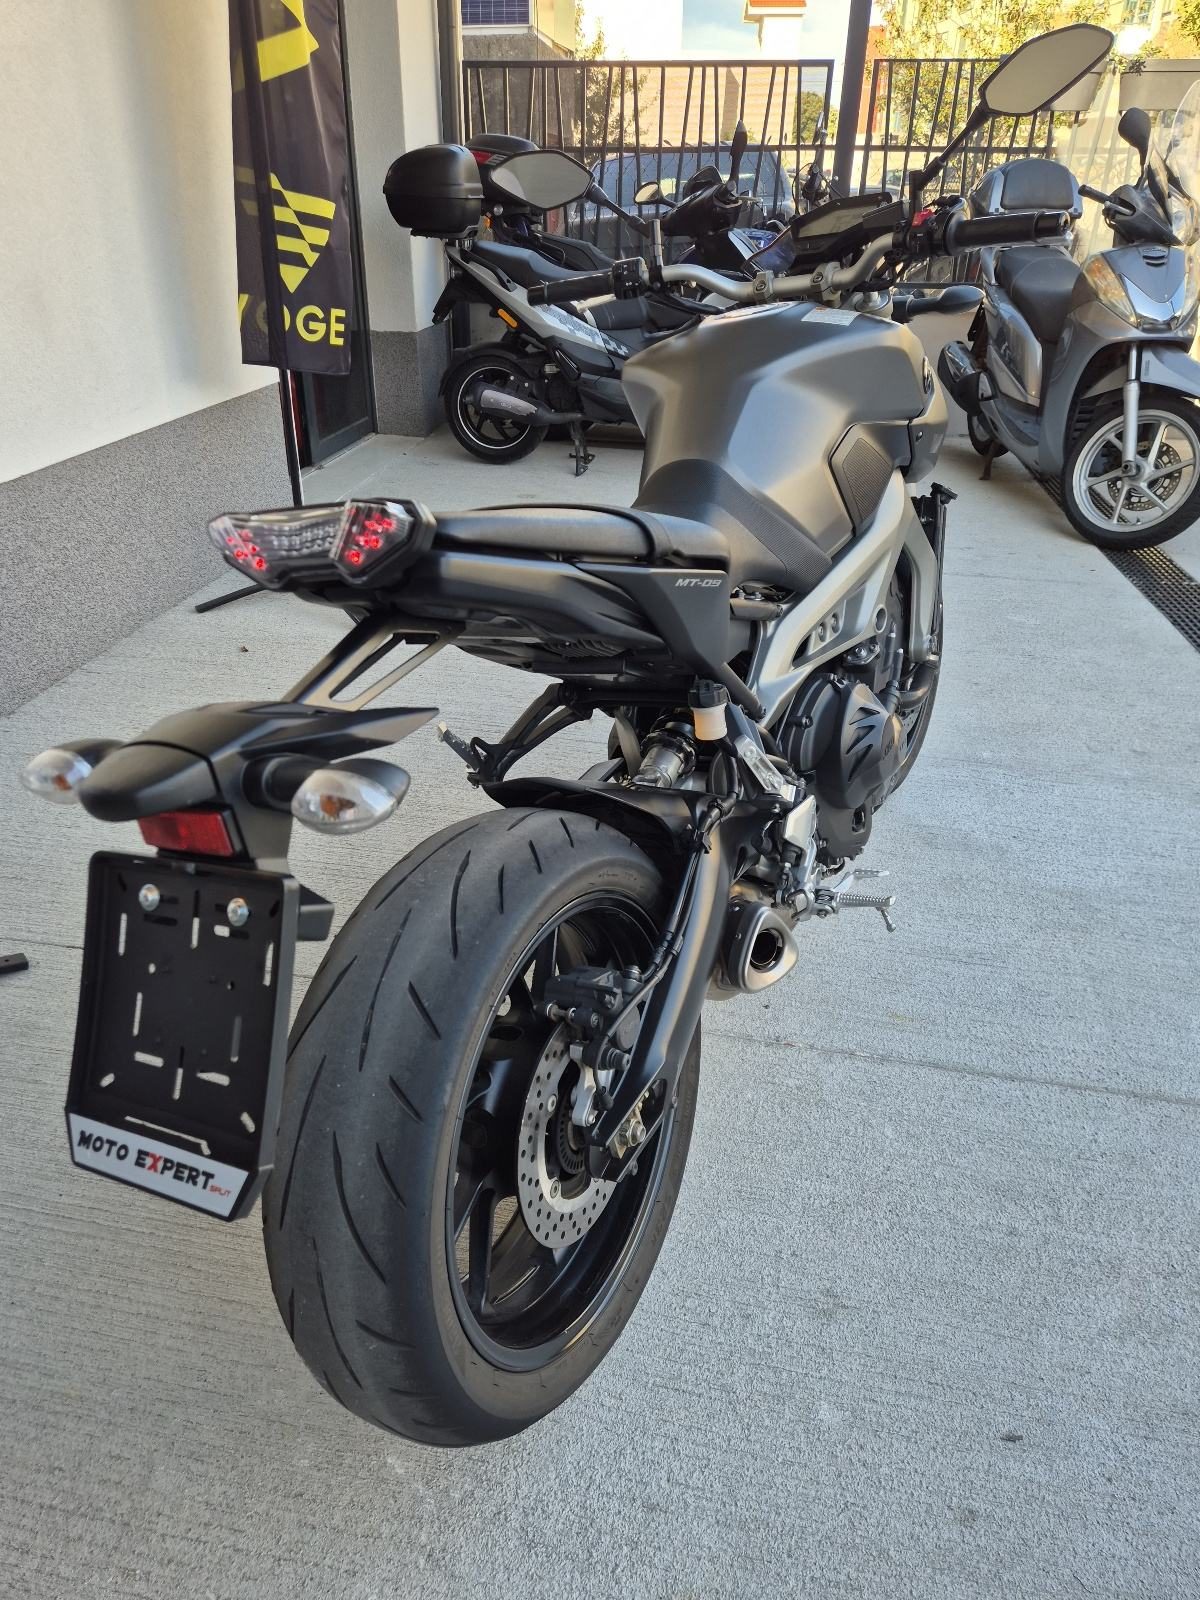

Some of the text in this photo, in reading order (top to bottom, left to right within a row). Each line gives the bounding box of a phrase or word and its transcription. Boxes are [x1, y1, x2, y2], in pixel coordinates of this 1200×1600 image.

[675, 578, 722, 587] MT-09
[77, 1130, 129, 1161] MOTO
[134, 1148, 215, 1190] EXPERT
